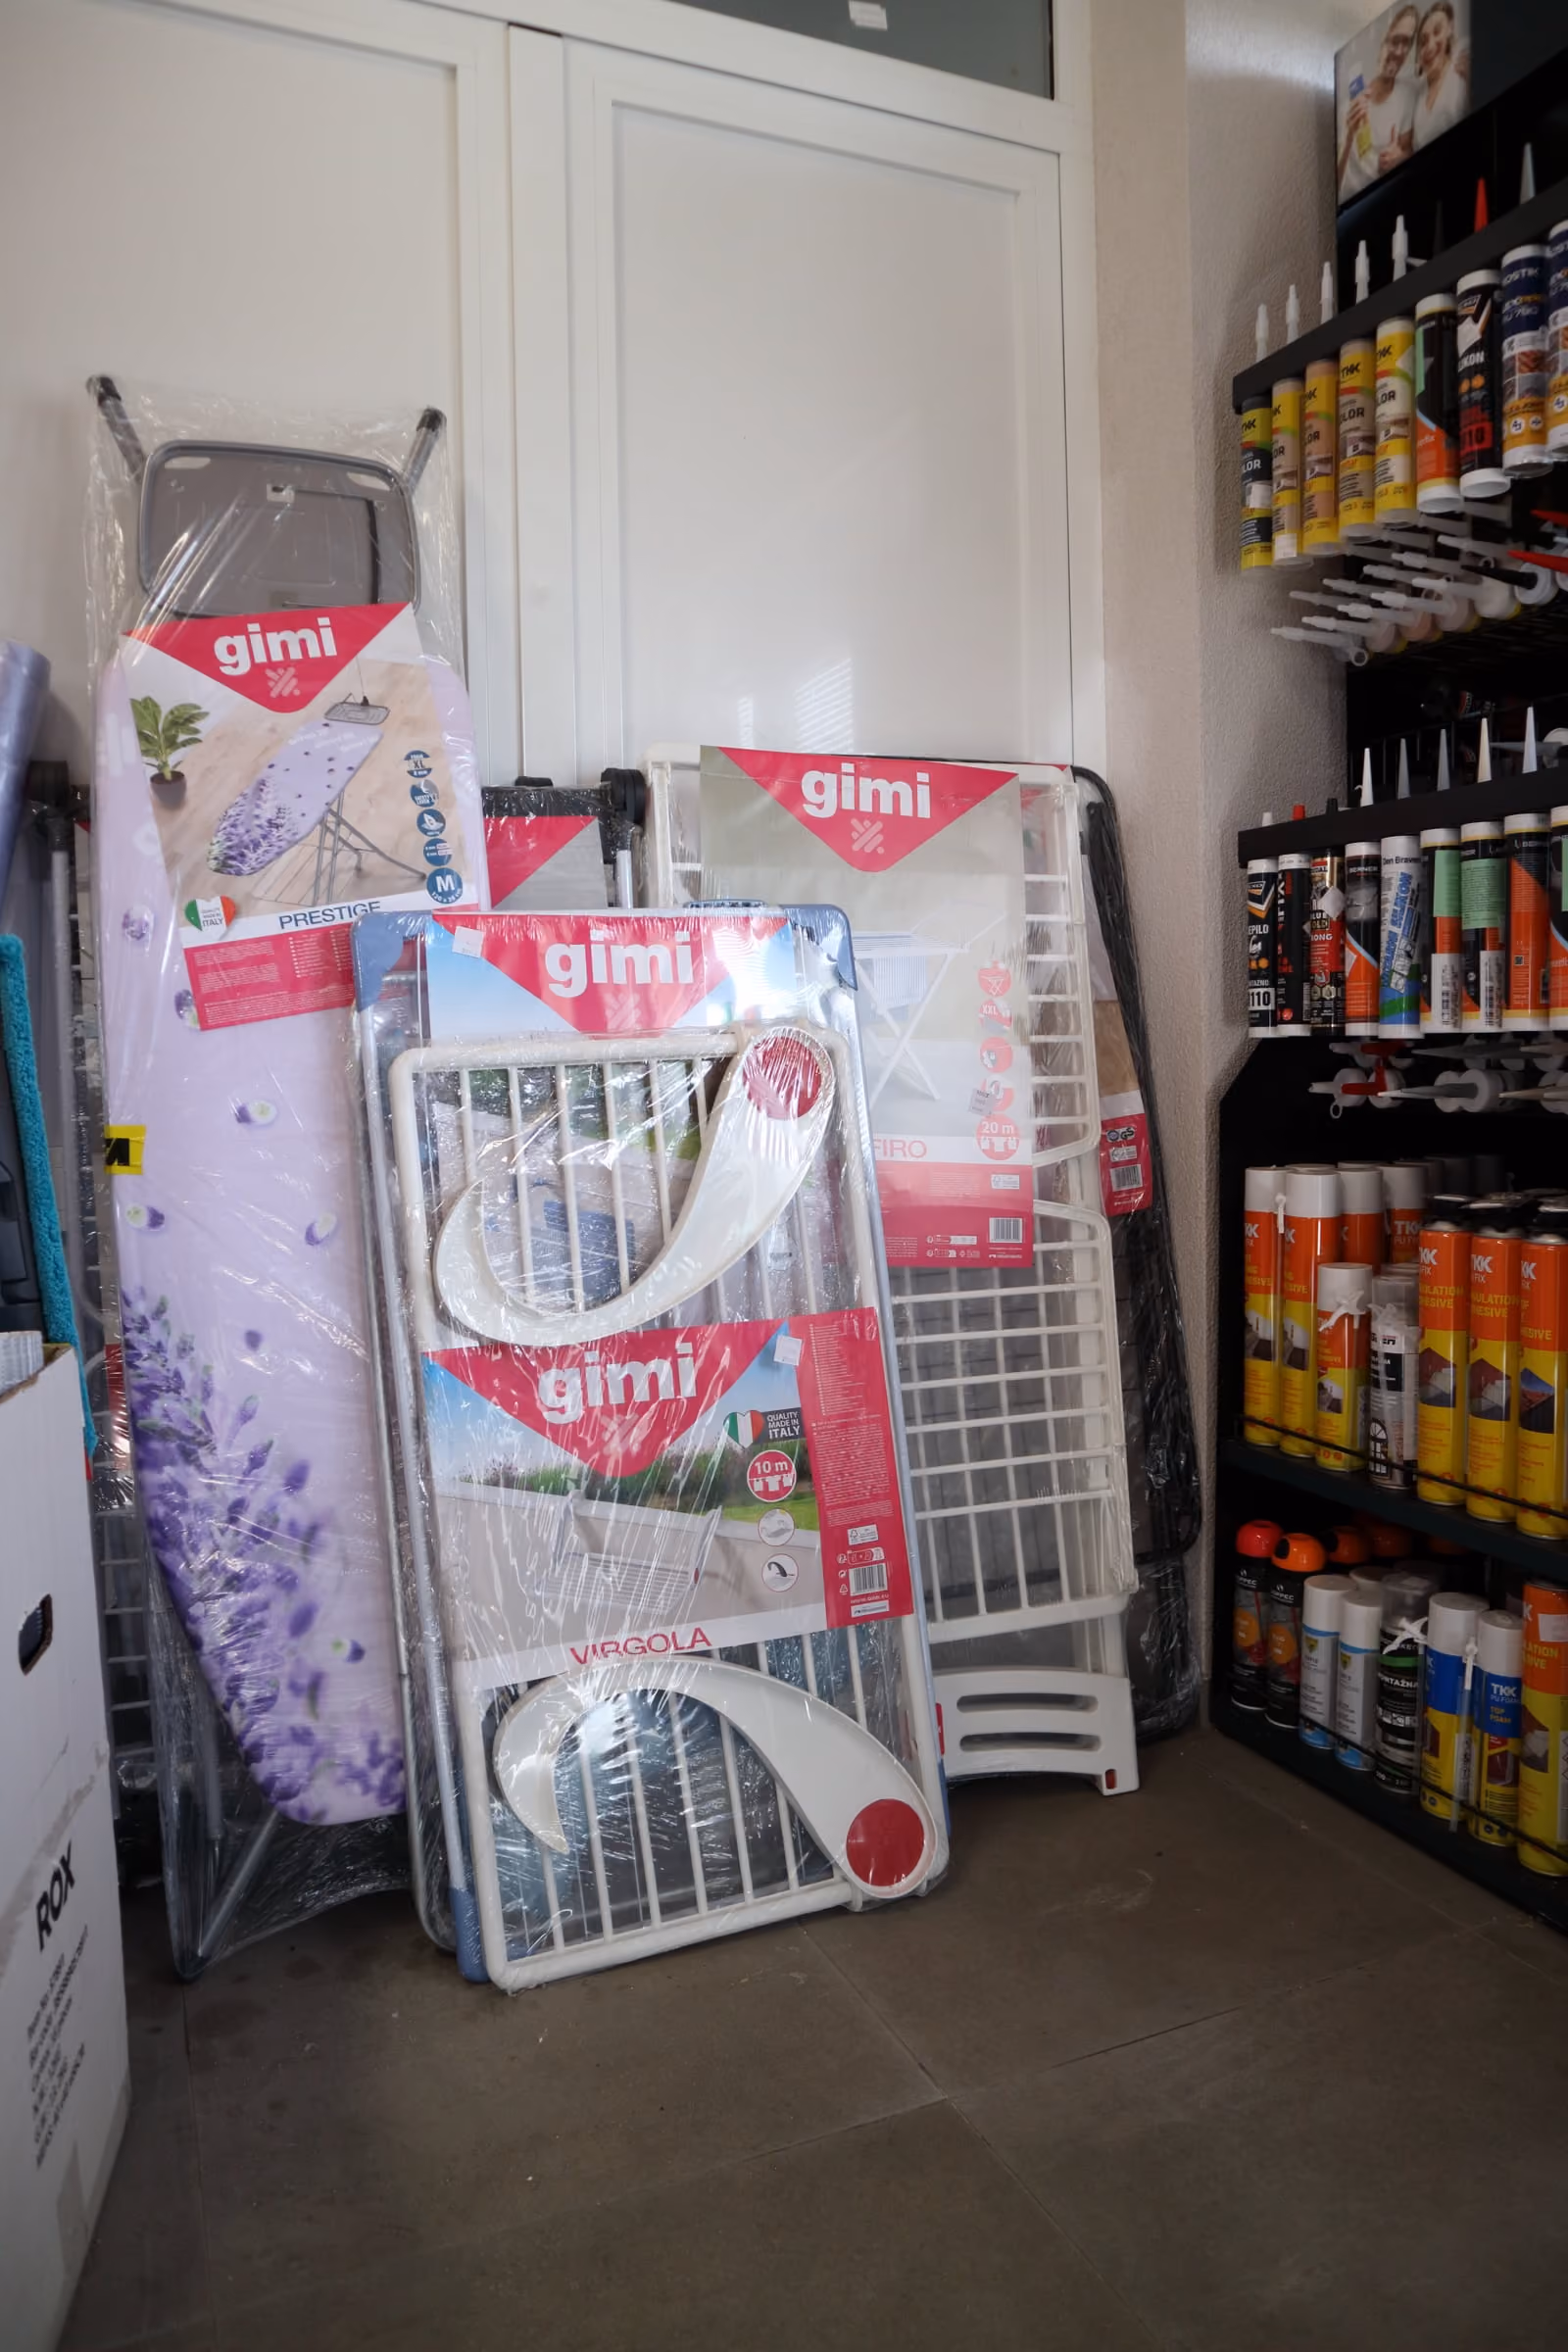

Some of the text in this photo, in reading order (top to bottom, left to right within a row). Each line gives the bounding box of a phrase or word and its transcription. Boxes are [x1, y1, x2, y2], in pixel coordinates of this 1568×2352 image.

[1503, 267, 1540, 286] OSTIK
[213, 616, 338, 676] gimi
[801, 761, 932, 819] gimi
[435, 874, 456, 893] M
[278, 901, 381, 930] PRESTIGE
[1248, 924, 1269, 936] EPILO
[545, 929, 694, 998] gimi
[981, 1121, 1013, 1135] 20 m
[1420, 1247, 1438, 1265] KK
[538, 1342, 697, 1425] gimi
[766, 1410, 799, 1422] QUALITY
[767, 1417, 800, 1429] MADE IN
[768, 1425, 801, 1440] ITALY
[754, 1460, 789, 1475] 10 m
[569, 1626, 712, 1665] VIRGOLA
[1490, 1683, 1518, 1697] TKK
[36, 1839, 75, 1953] ROX
